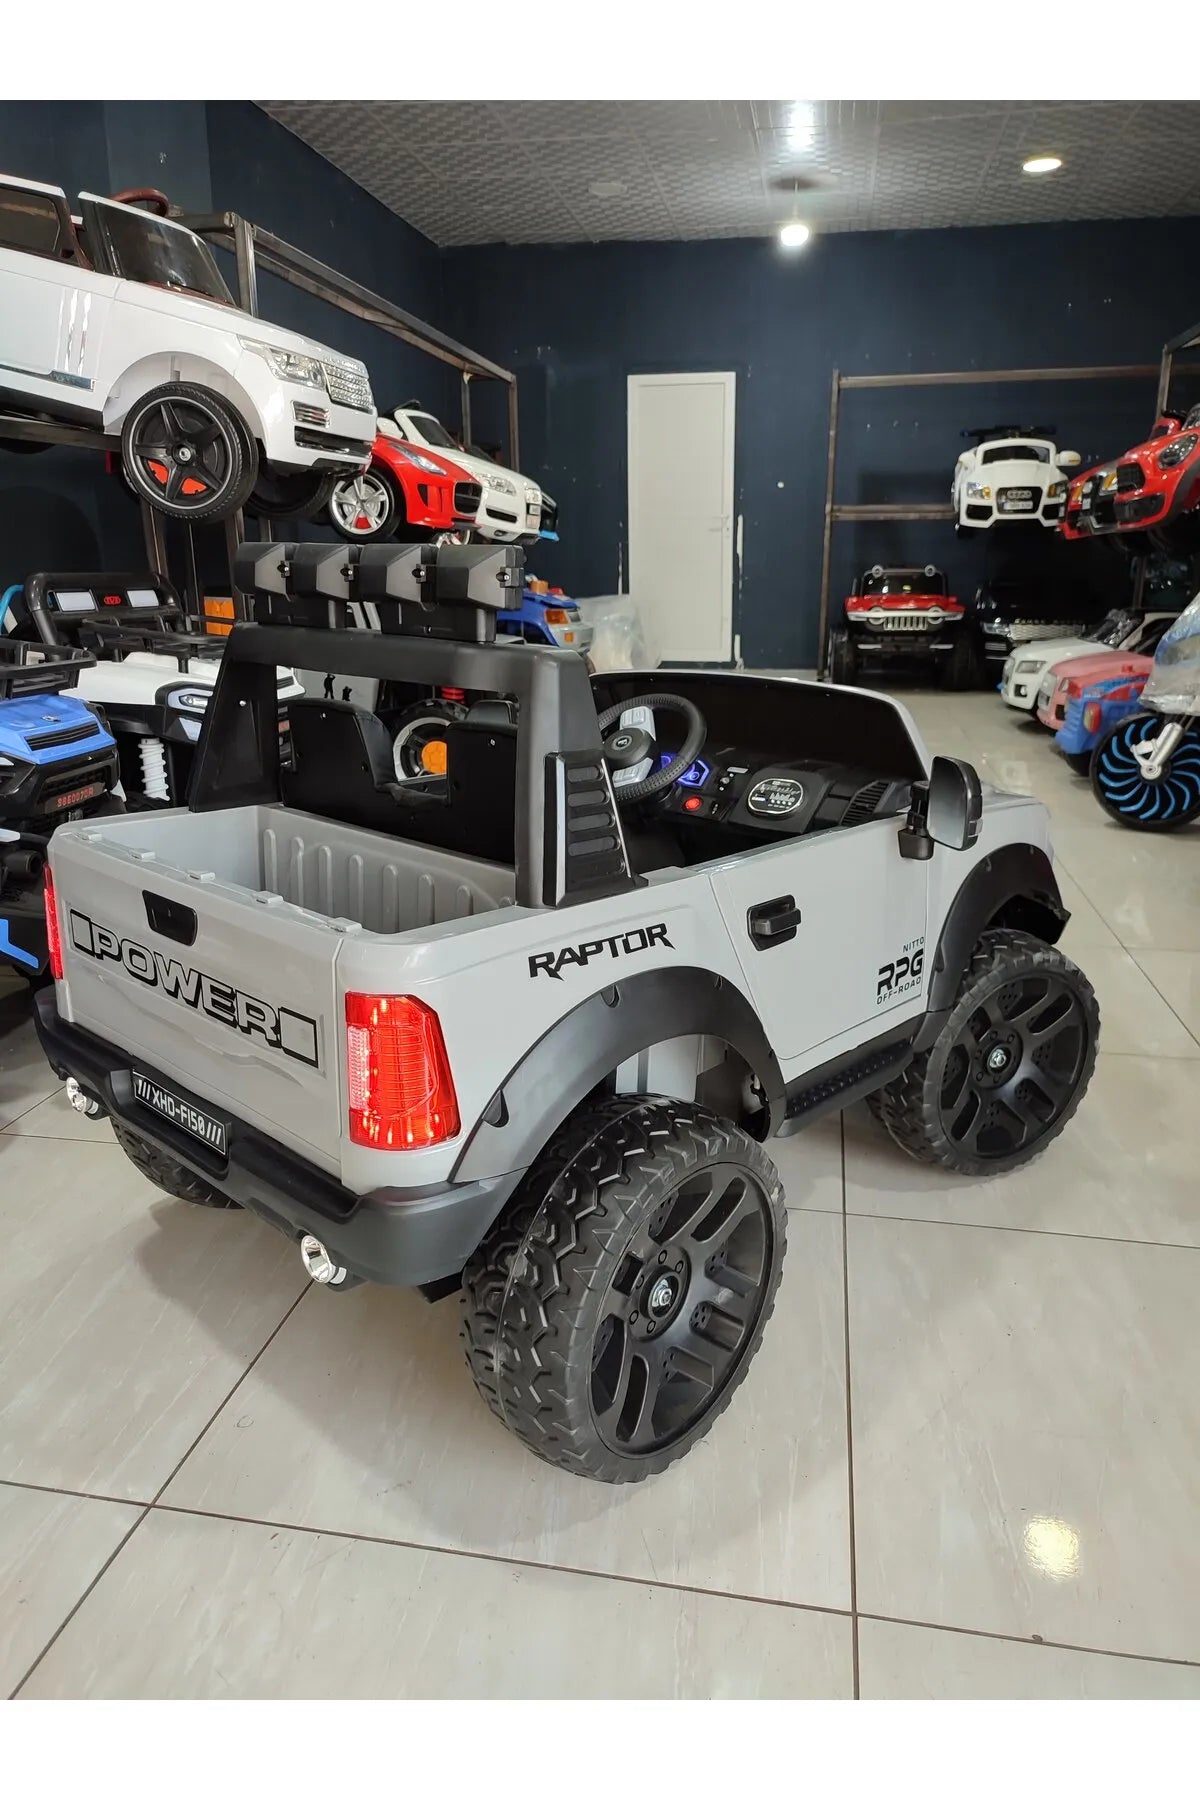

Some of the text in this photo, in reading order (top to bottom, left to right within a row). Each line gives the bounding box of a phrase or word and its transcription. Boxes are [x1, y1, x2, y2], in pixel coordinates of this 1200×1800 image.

[528, 922, 676, 981] RAPTOR
[902, 936, 925, 953] NITTO
[91, 921, 282, 1049] POWER
[876, 947, 924, 996] RPG
[876, 976, 922, 1005] OFF-ROAD
